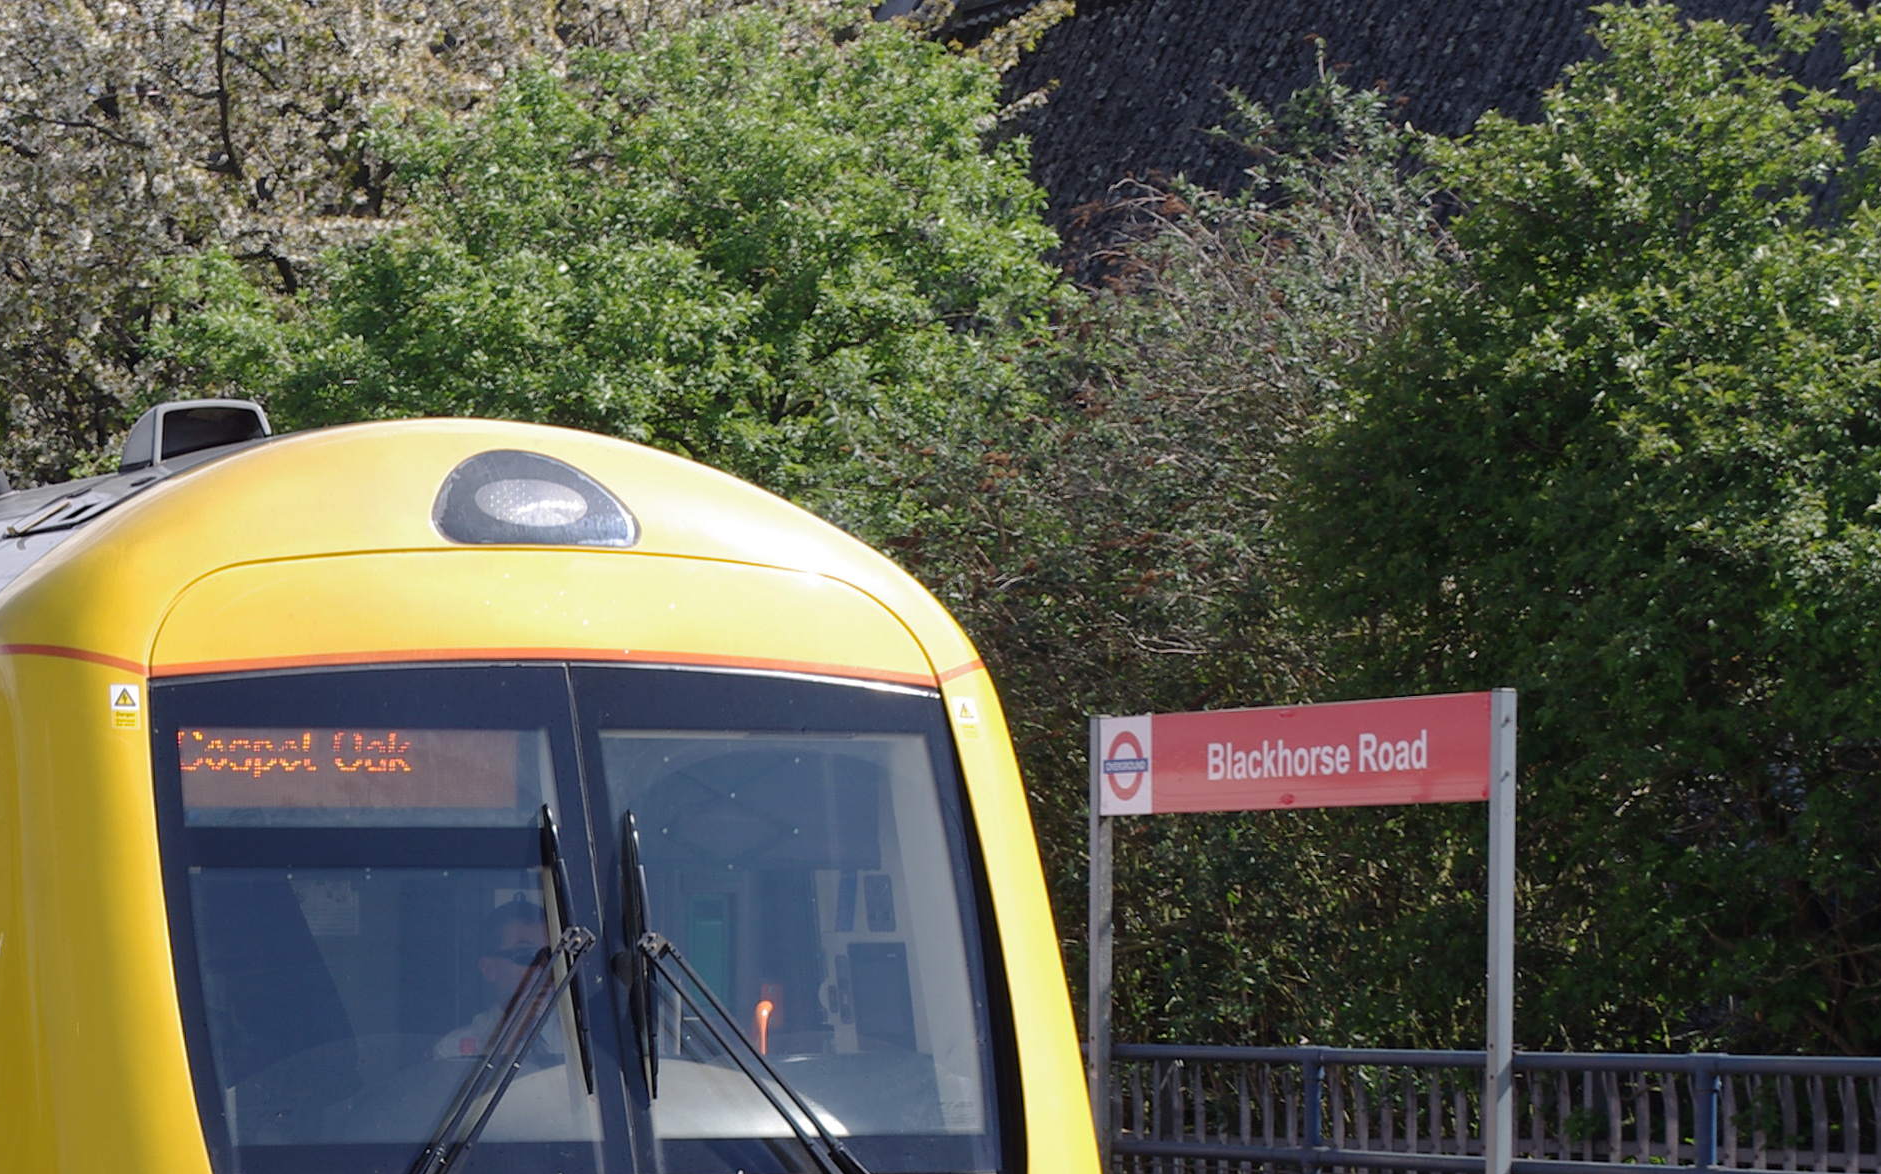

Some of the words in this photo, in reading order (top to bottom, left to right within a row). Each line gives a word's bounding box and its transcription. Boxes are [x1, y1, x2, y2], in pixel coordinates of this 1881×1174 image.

[332, 731, 411, 773] Oak
[1207, 739, 1350, 781] Blackhorse
[1358, 729, 1428, 772] Road
